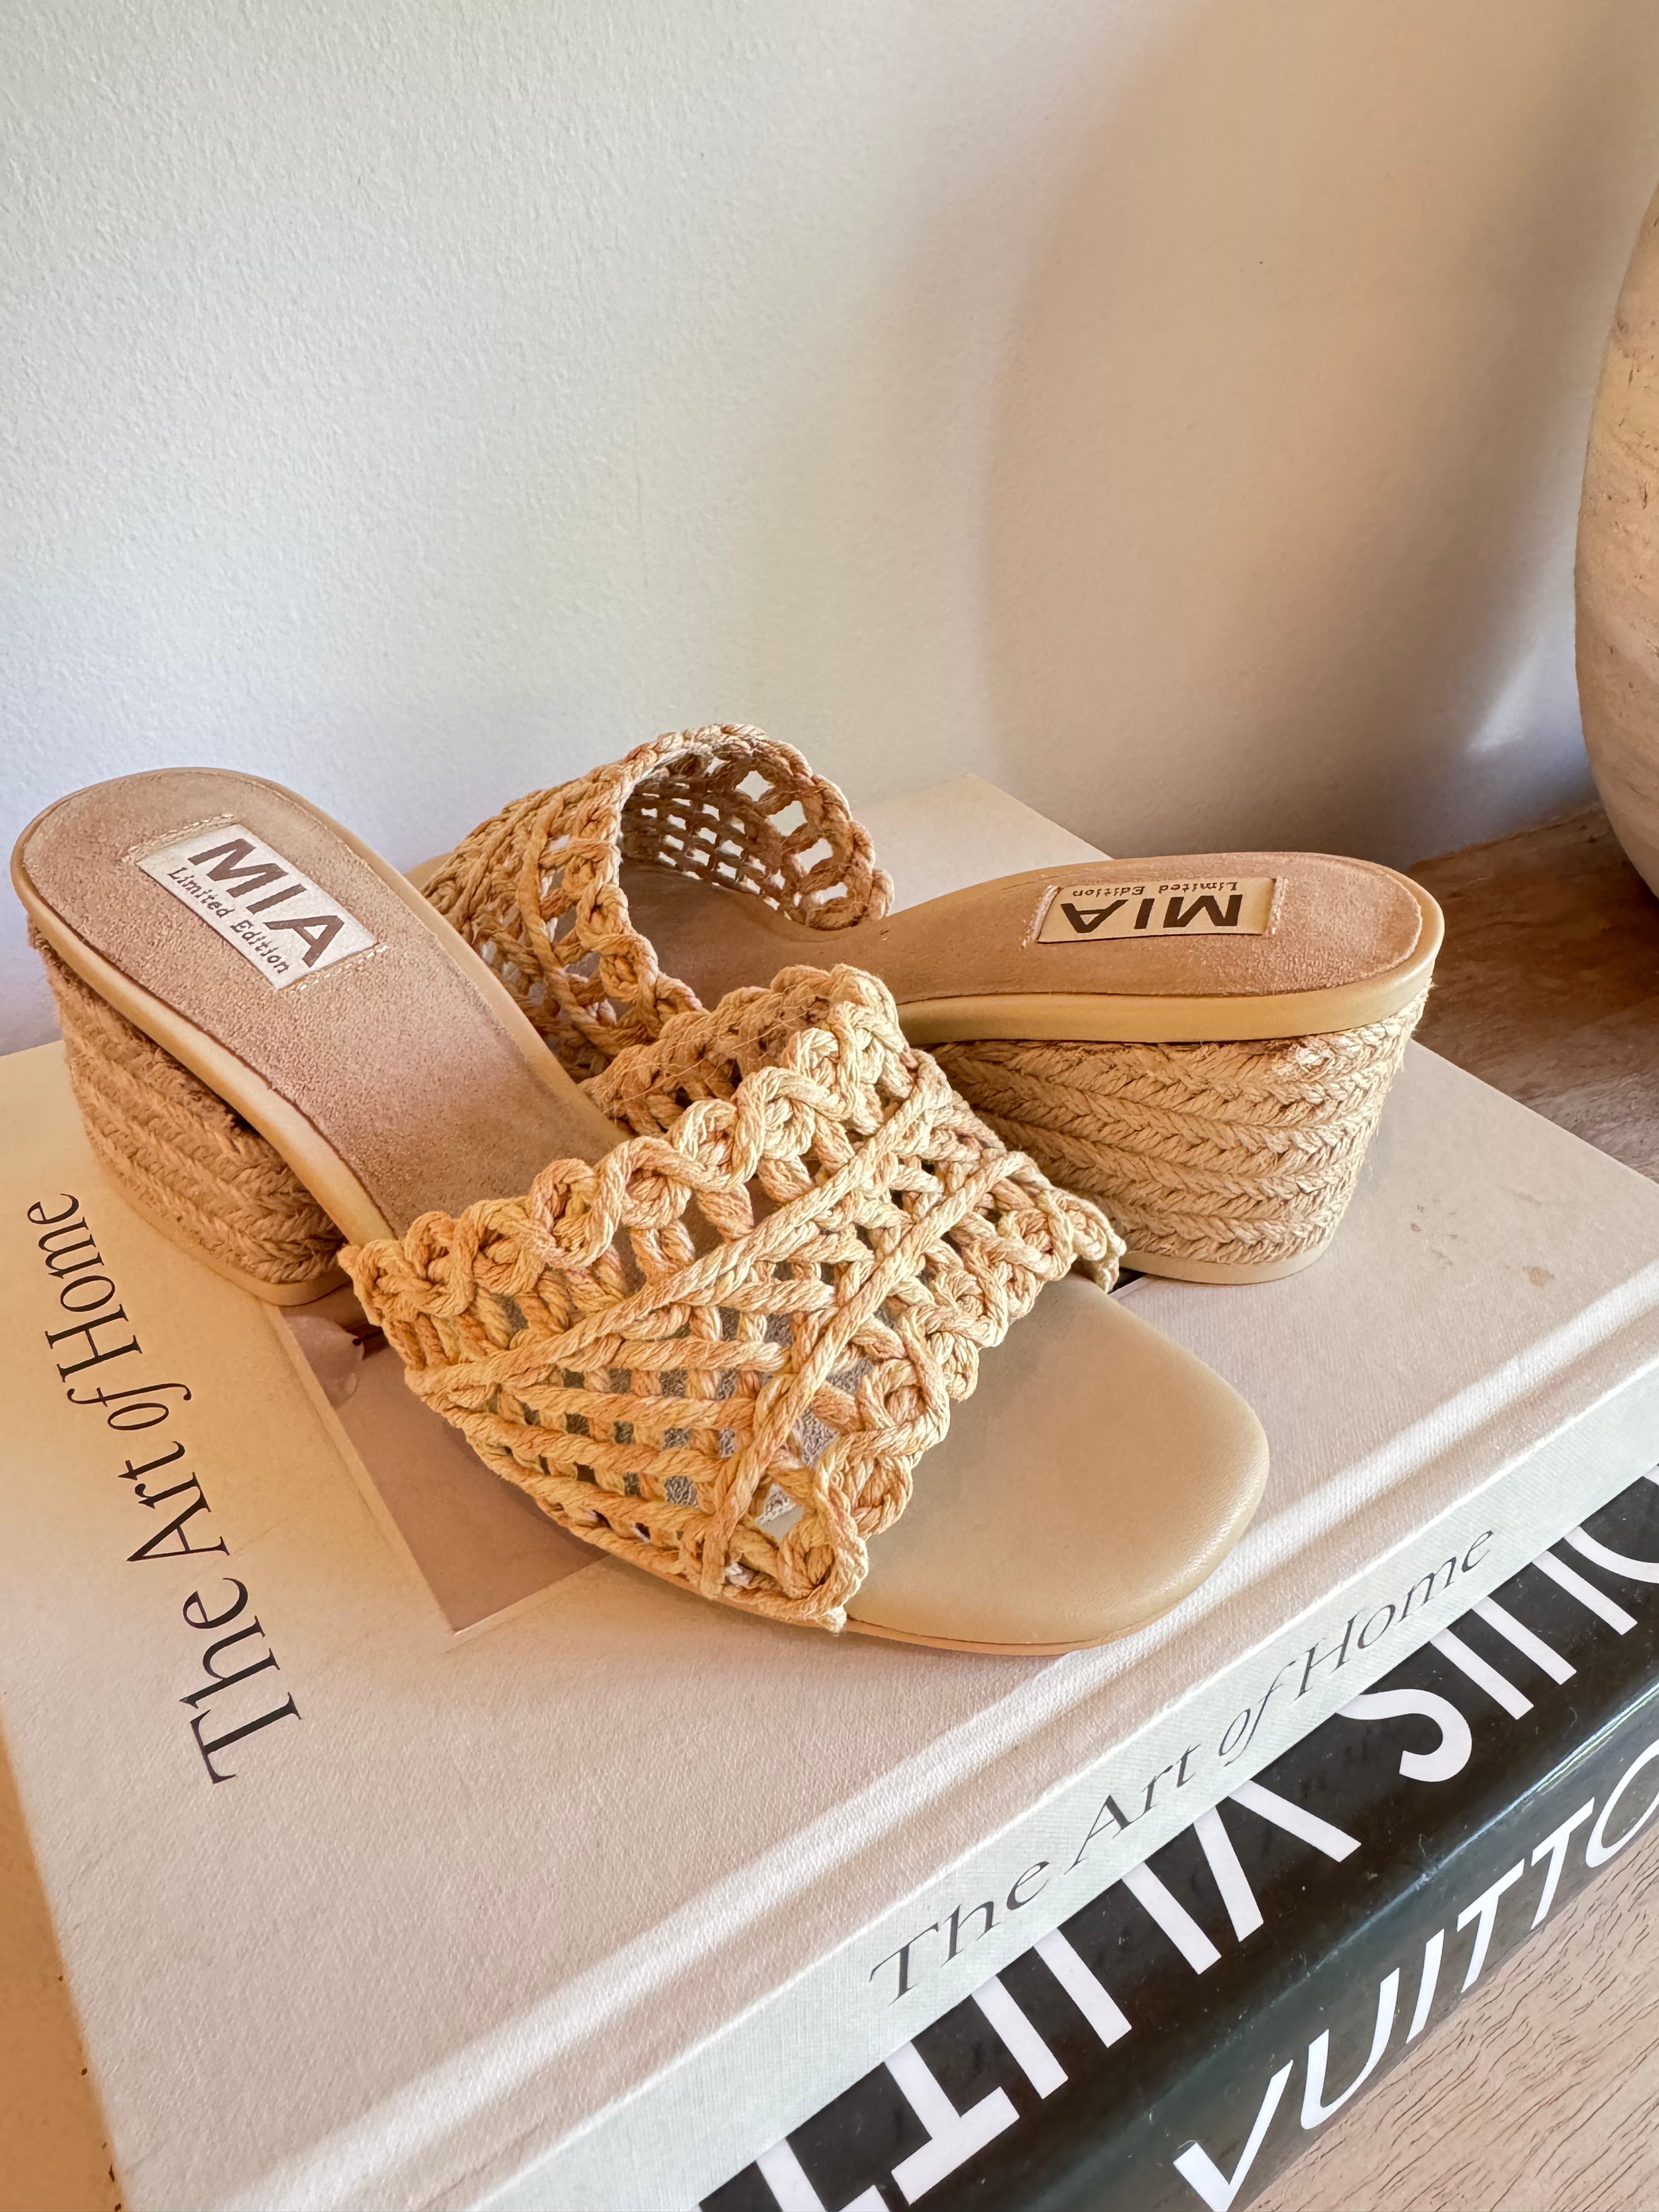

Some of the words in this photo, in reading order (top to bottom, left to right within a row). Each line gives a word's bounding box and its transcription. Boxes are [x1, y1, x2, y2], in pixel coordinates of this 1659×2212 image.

[167, 866, 236, 919] Limited
[230, 919, 292, 974] Edition
[188, 838, 346, 968] MIA
[1060, 894, 1243, 933] MIA
[1073, 885, 1146, 898] Edition
[1158, 881, 1238, 894] Limited
[26, 1193, 143, 1383] Home
[66, 1381, 191, 1431] of
[117, 1440, 230, 1562] Art
[179, 1577, 302, 1784] The
[868, 1860, 1050, 2007] The
[1064, 1743, 1201, 1875] Art
[1218, 1661, 1296, 1767] of
[1293, 1530, 1493, 1702] Home
